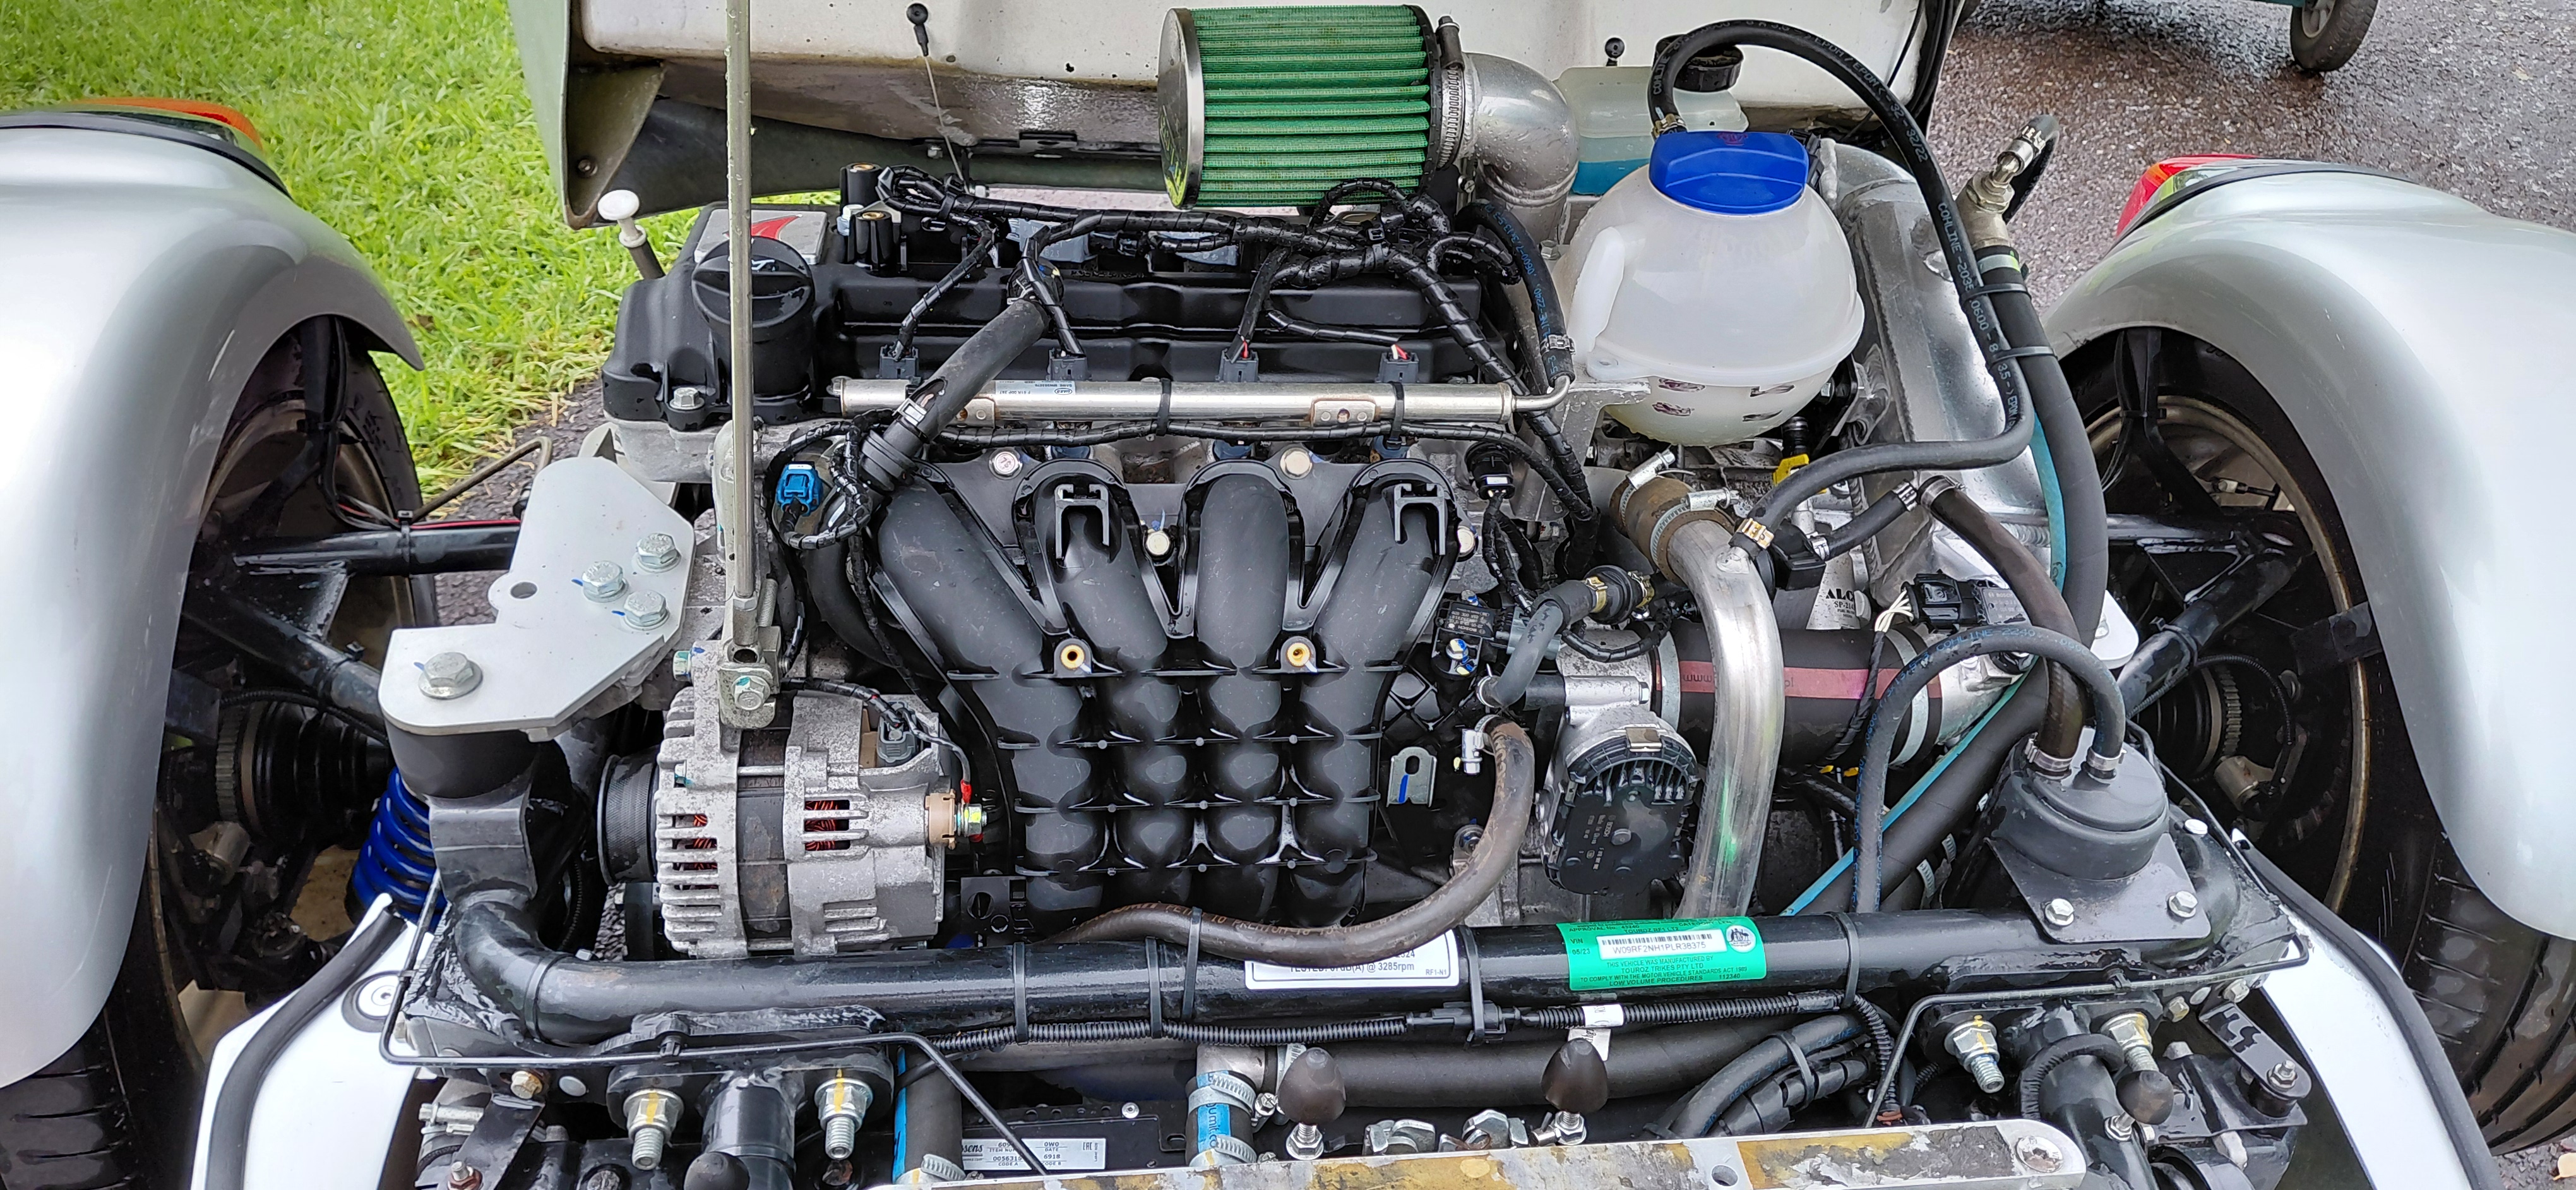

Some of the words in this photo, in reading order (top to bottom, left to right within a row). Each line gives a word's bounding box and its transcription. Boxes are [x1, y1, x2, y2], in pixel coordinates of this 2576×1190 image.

[1937, 201, 1962, 254] COHLINE
[1603, 821, 1614, 838] BOSCH
[1613, 941, 1707, 954] W09RF2NH1PLR38375
[1660, 956, 1705, 965] MANUFACTURED
[1367, 962, 1376, 973] @
[1378, 962, 1415, 973] 3285rpm
[1426, 968, 1447, 977] RF1-N1
[1589, 975, 1613, 983] COMPLY
[1688, 968, 1722, 977] STANDARDS
[1657, 975, 1703, 983] PROCEDURES
